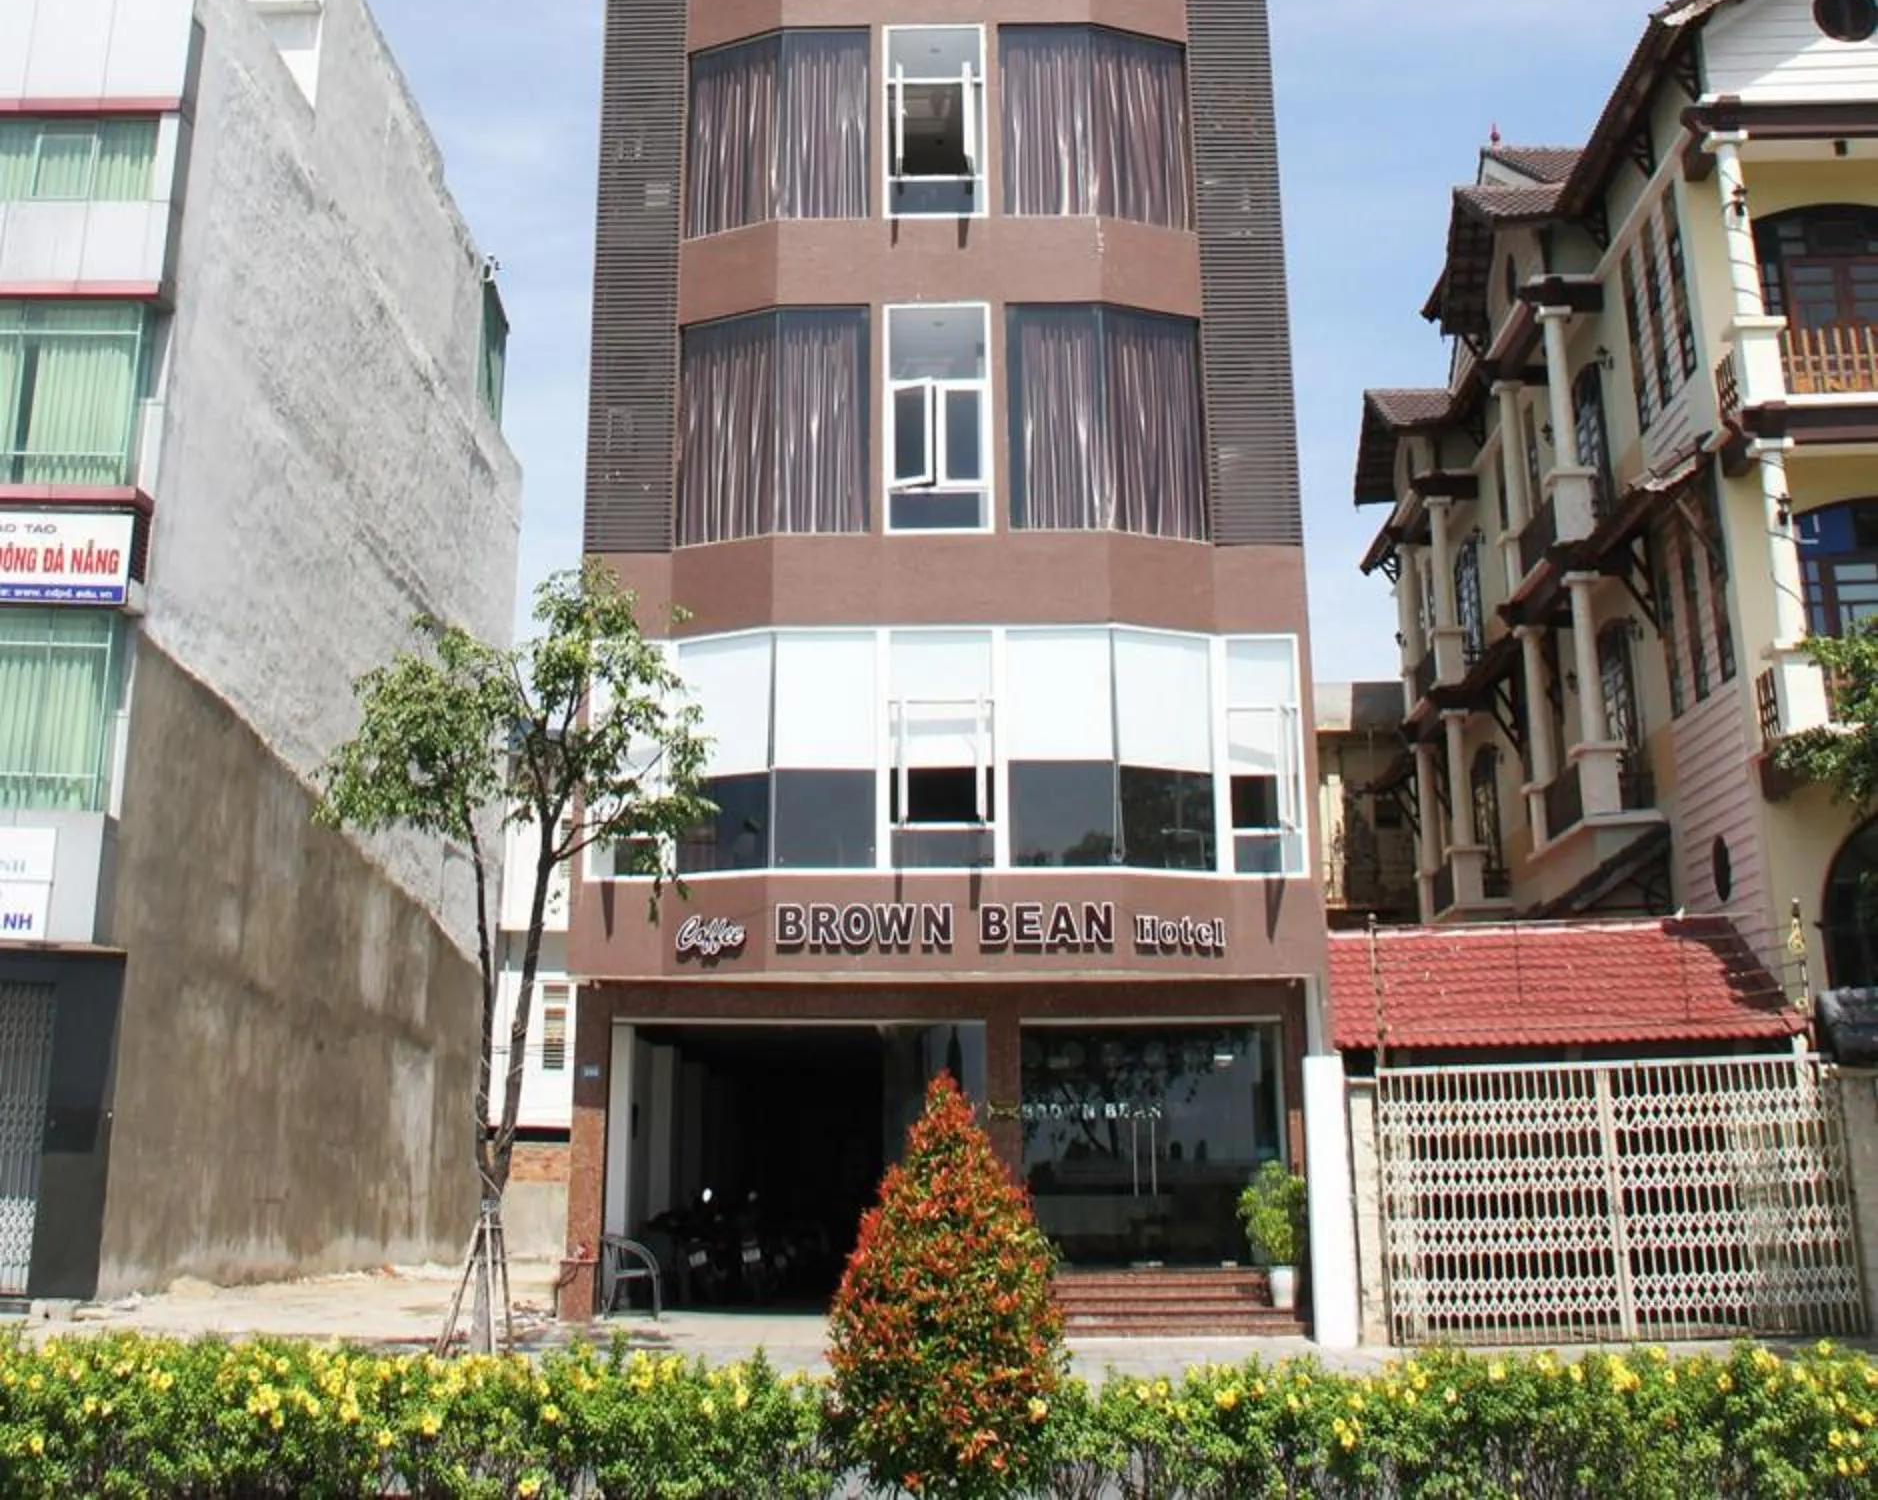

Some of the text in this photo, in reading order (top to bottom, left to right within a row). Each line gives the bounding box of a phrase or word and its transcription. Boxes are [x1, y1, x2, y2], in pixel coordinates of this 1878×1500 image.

[0, 913, 33, 931] NH
[675, 902, 1227, 956] Coffee BROWN BEAN Hotel
